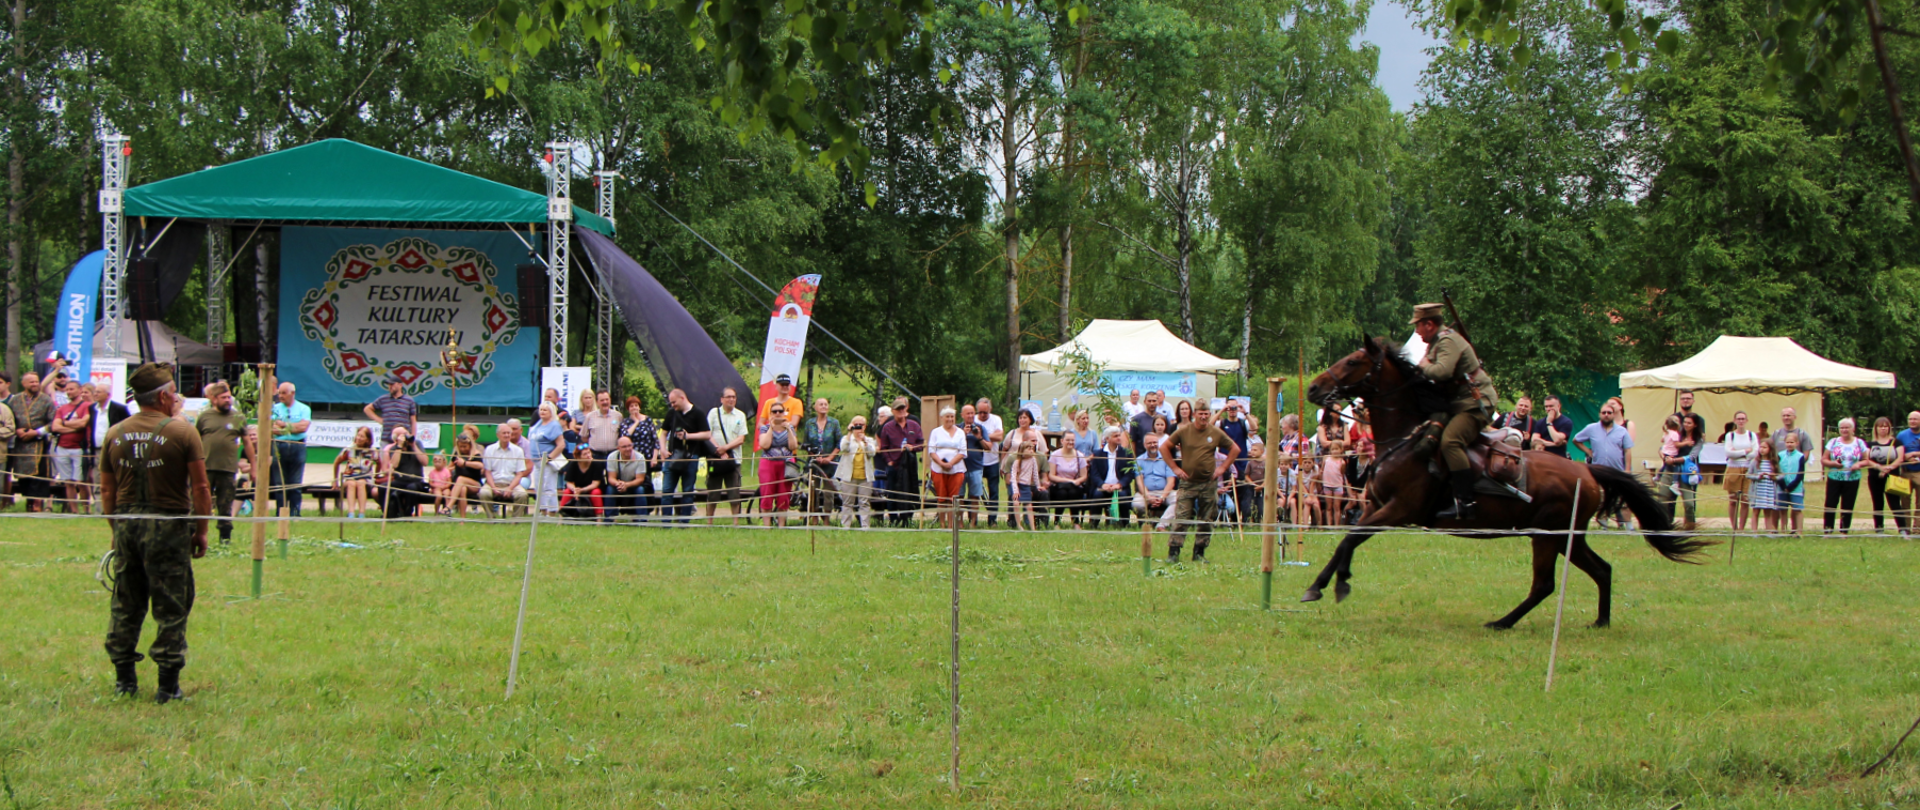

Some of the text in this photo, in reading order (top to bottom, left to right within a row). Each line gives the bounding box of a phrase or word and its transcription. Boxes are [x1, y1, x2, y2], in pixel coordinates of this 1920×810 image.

[367, 285, 462, 302] FESTIWAL
[368, 306, 460, 324] KULTURY
[774, 337, 800, 348] KOCHAM
[774, 345, 798, 357] POLSKĘ
